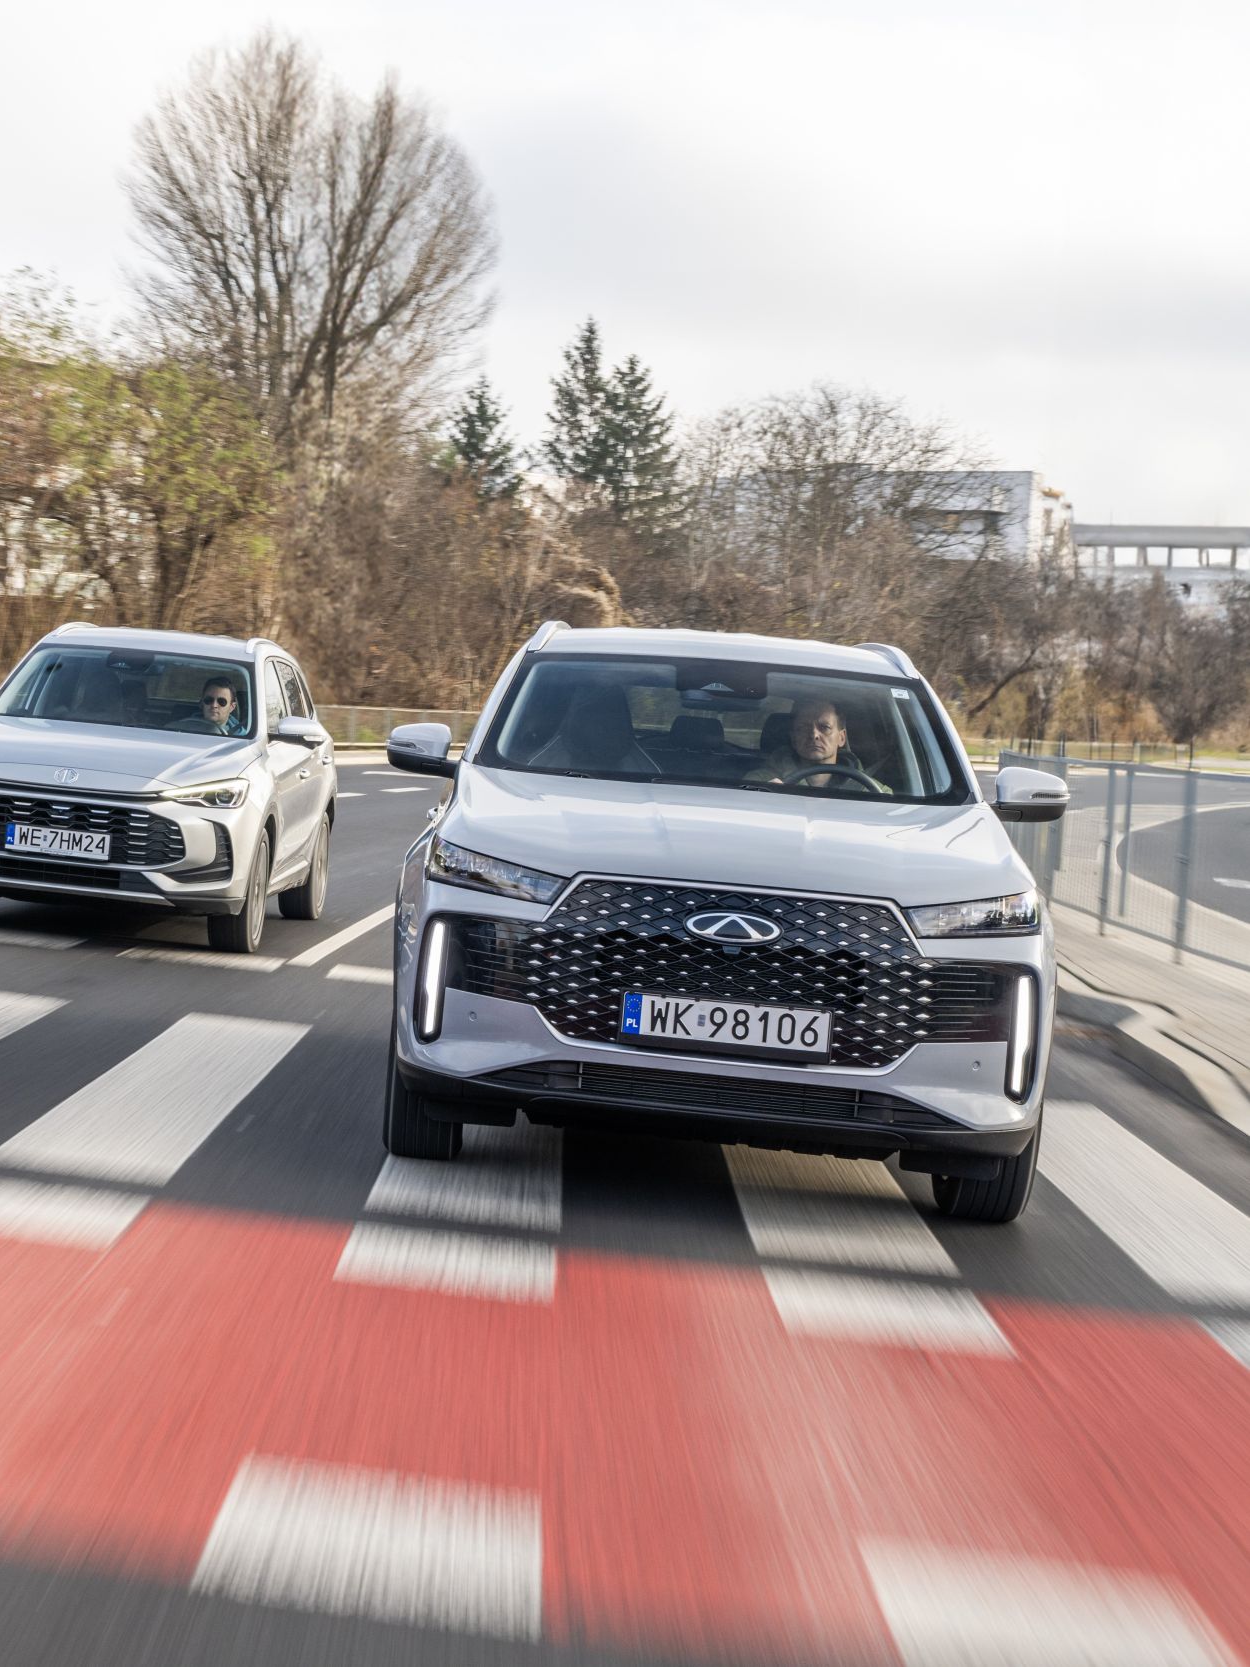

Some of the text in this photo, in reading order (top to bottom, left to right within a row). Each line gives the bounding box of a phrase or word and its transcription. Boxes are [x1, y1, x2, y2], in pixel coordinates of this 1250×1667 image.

[18, 827, 106, 854] WE 7HM24
[626, 1018, 638, 1028] PL
[650, 1000, 820, 1047] WK 98106
